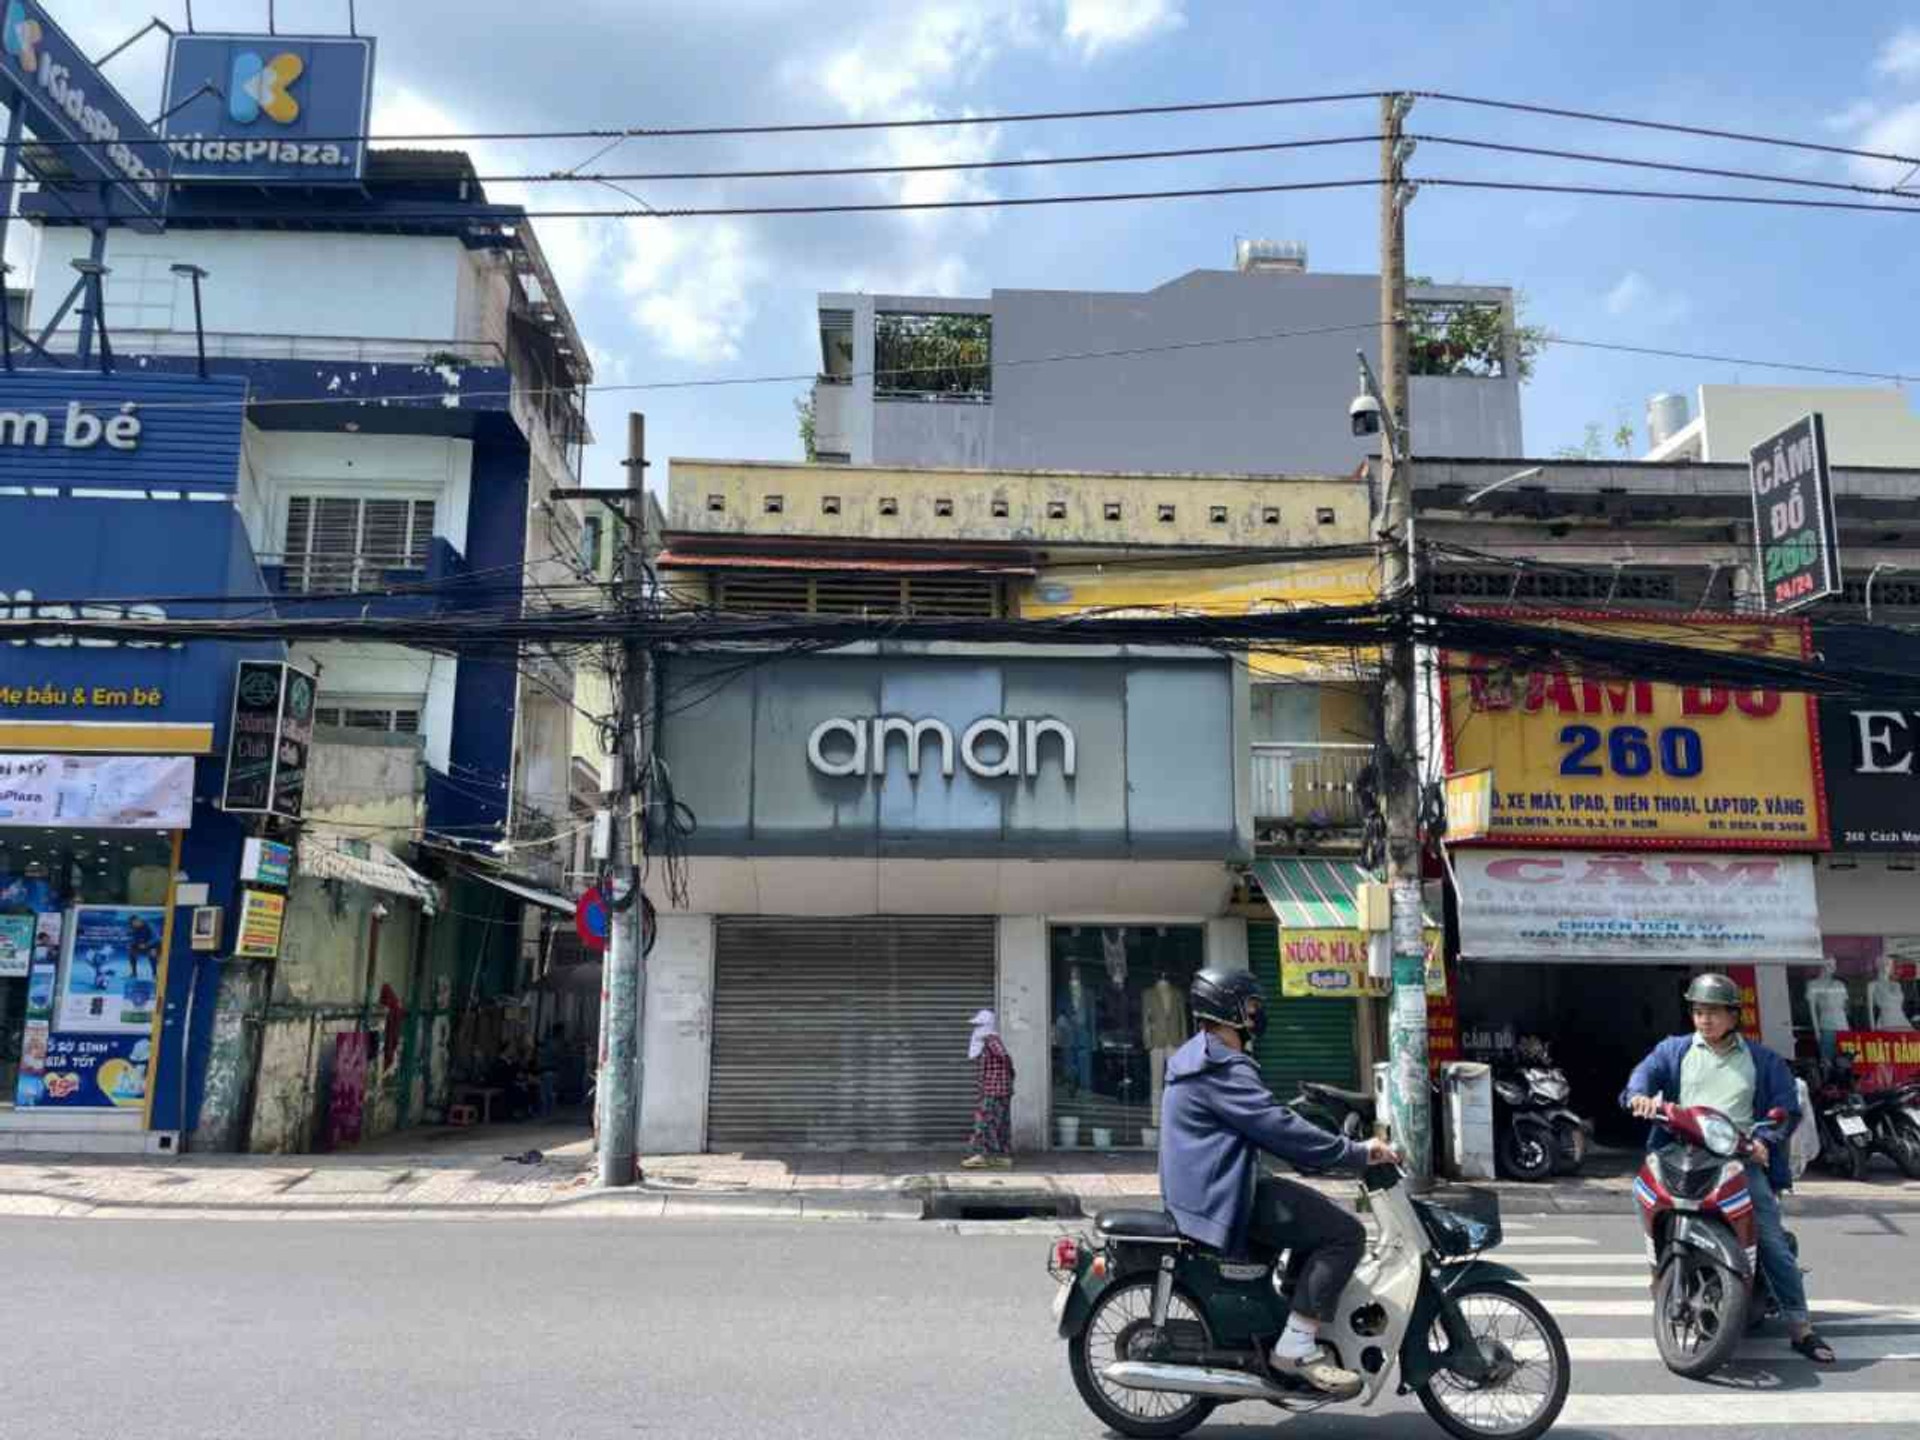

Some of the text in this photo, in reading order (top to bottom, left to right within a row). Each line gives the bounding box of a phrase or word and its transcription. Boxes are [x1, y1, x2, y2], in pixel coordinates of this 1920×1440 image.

[64, 401, 141, 448] bé
[72, 687, 86, 705] &
[93, 687, 127, 705] Em
[132, 687, 161, 706] bé
[807, 717, 1076, 776] aman
[1559, 724, 1703, 778] 260
[1850, 711, 1920, 774] E
[1507, 792, 1525, 809] XE
